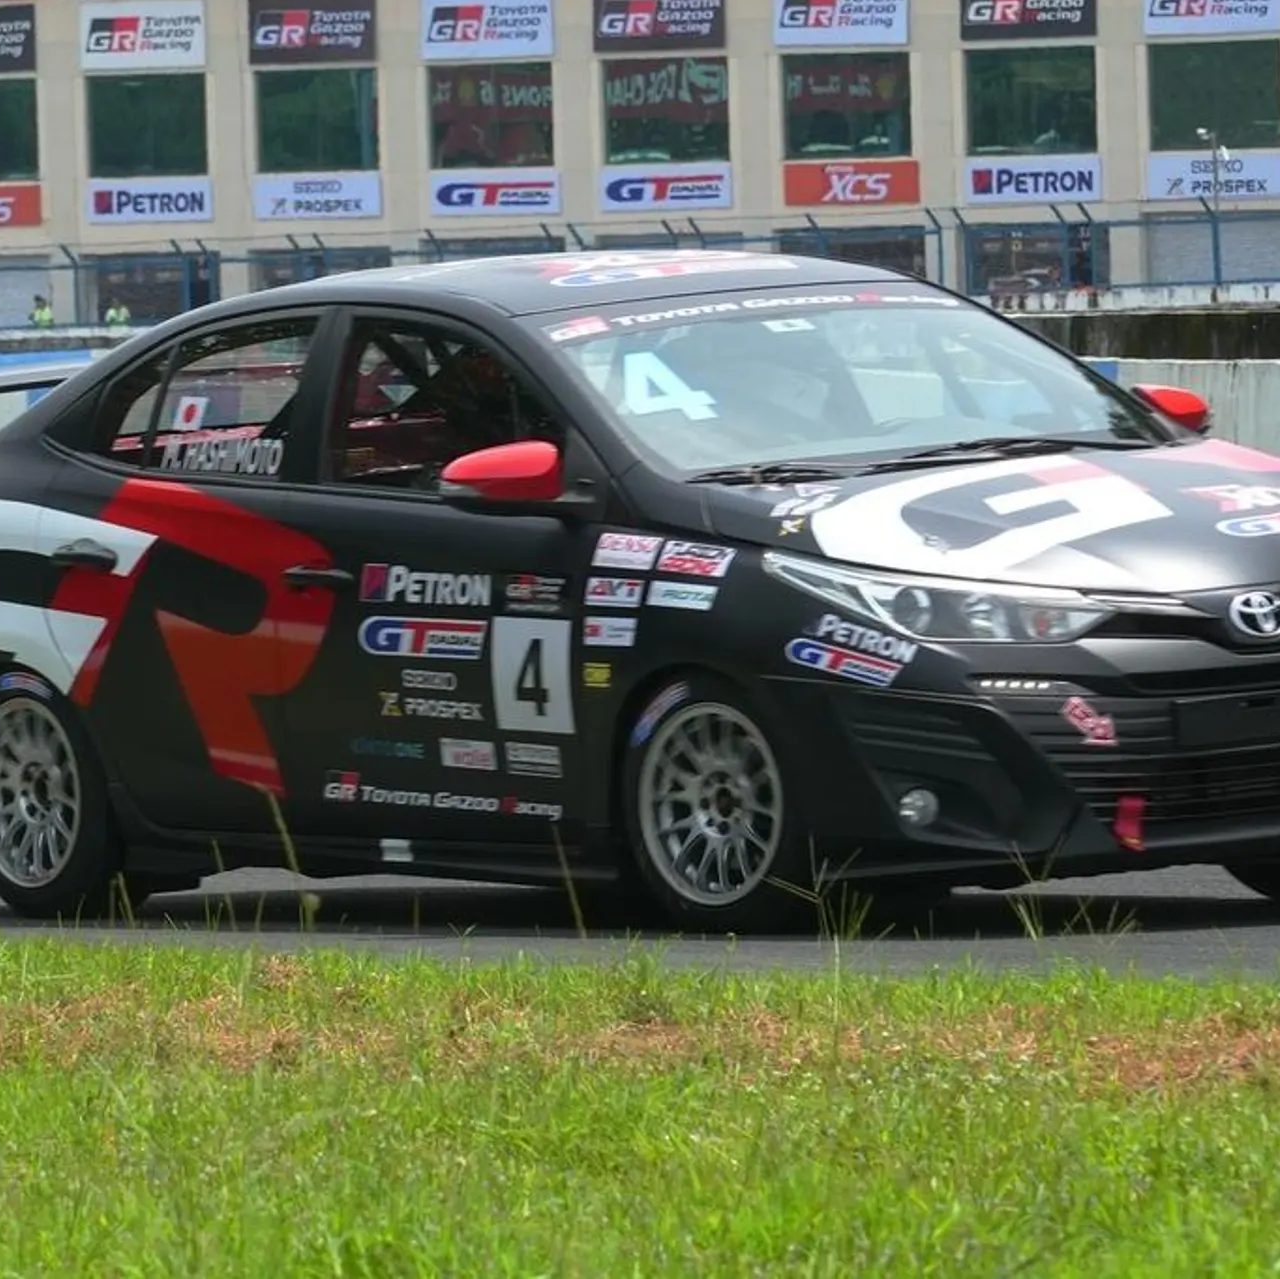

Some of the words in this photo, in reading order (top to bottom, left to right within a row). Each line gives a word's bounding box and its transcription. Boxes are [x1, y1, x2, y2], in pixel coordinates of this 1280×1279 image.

[312, 11, 371, 21] TOYOTA
[489, 6, 547, 16] TOYOTA
[657, 10, 713, 20] GAZOO
[782, 6, 834, 27] GR
[840, 4, 896, 14] GAZOO
[968, 0, 1020, 21] GR
[146, 16, 201, 26] TOYOTA
[310, 23, 365, 33] GAZOO
[429, 21, 480, 40] GR
[486, 18, 540, 28] GAZOO
[601, 14, 652, 34] GR
[87, 32, 135, 51] GR
[142, 28, 194, 38] GAZOO
[257, 26, 306, 46] GR
[821, 173, 891, 201] XCS
[996, 171, 1093, 193] PETRON
[116, 191, 204, 214] PETRON
[293, 198, 362, 213] PROSPEX
[611, 303, 741, 326] TOYOTA
[623, 351, 718, 420] 4
[385, 565, 491, 607] PETRON
[817, 614, 919, 664] PETRON
[515, 637, 549, 717] 4
[403, 697, 485, 720] PROSPEX
[360, 786, 431, 806] TOYOTA
[433, 792, 500, 812] GAZOO
